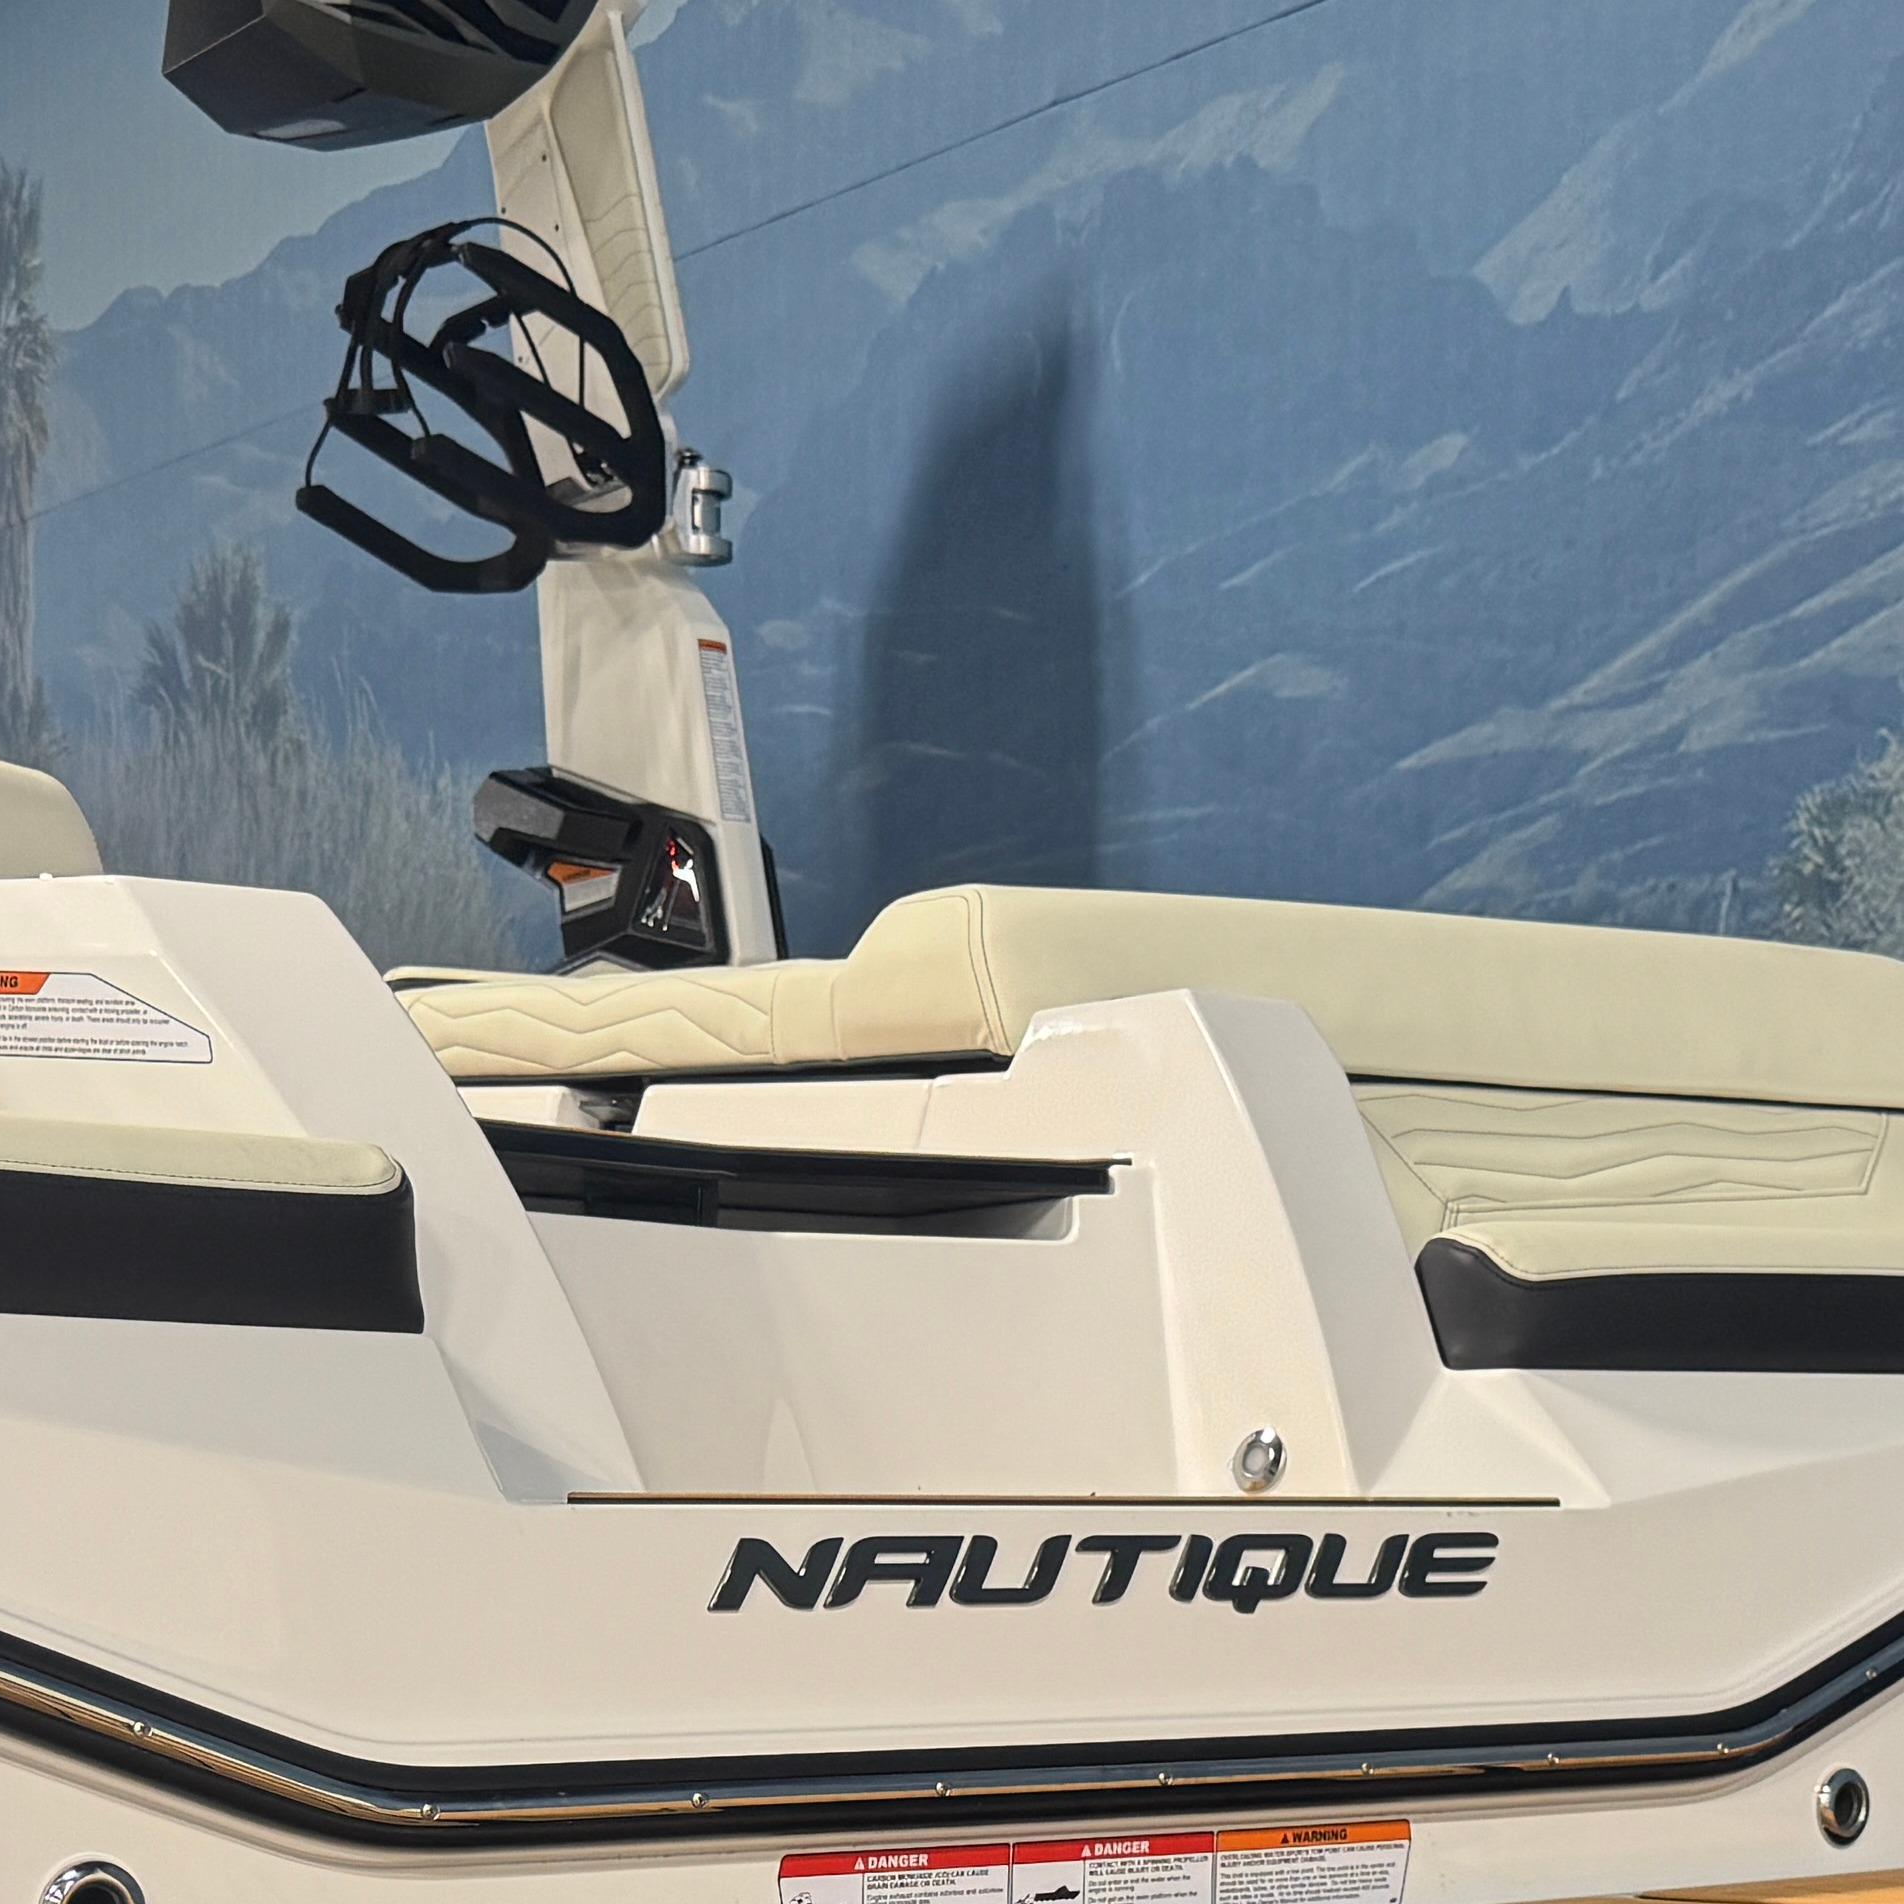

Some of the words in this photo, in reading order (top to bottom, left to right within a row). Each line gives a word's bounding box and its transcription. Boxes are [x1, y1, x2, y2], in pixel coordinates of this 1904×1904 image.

[708, 1532, 1499, 1614] NAUTIQUE
[1292, 1828, 1348, 1844] WARNING
[1094, 1841, 1150, 1856] DANGER
[868, 1853, 929, 1869] DANGER
